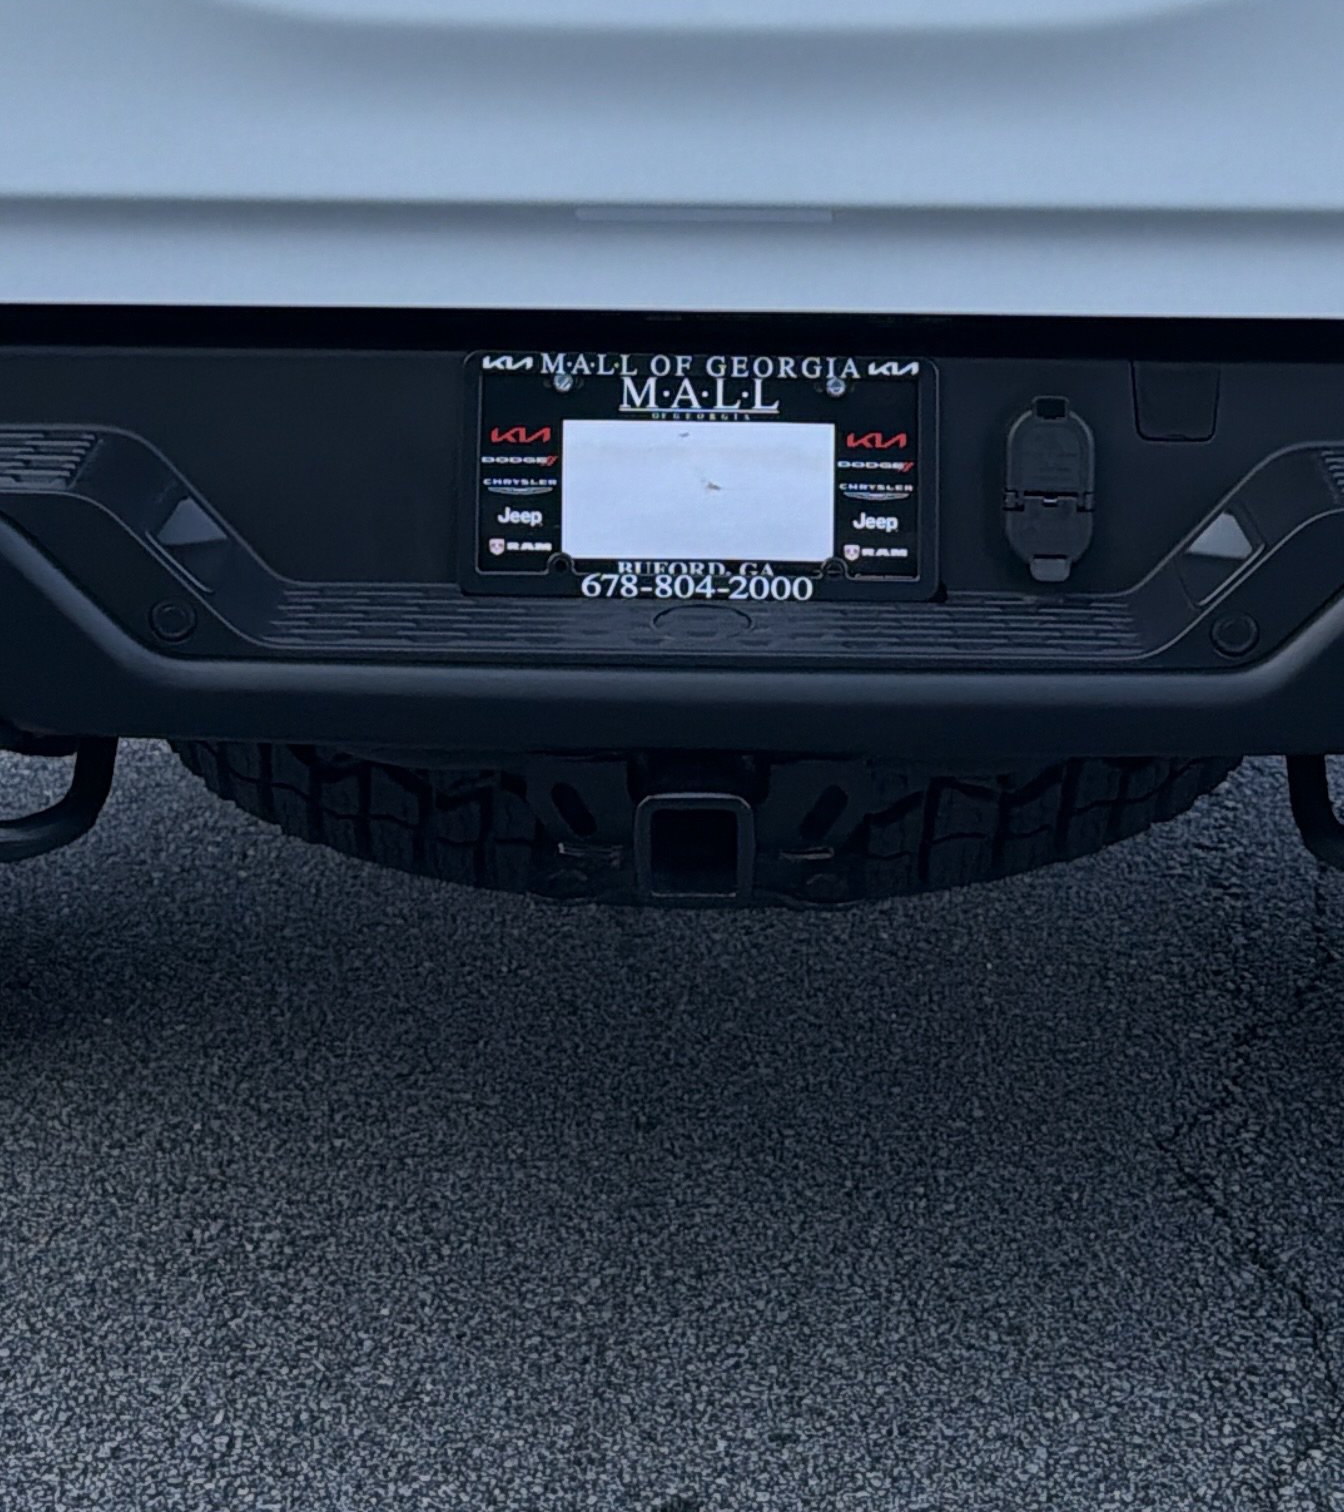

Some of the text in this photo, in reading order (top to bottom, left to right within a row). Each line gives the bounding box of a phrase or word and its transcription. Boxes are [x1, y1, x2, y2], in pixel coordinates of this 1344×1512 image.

[650, 355, 692, 377] OF
[705, 356, 860, 379] GEORGIA
[481, 456, 548, 464] DODGE
[837, 460, 903, 469] DODGE
[483, 478, 557, 486] CHRYSLER
[839, 483, 914, 491] CHRYSLER
[498, 506, 543, 527] Jeep
[853, 512, 898, 532] Jeep
[506, 541, 552, 551] RAM
[861, 547, 908, 557] RAM
[739, 562, 775, 577] GA
[581, 574, 813, 601] 678-804-2000
